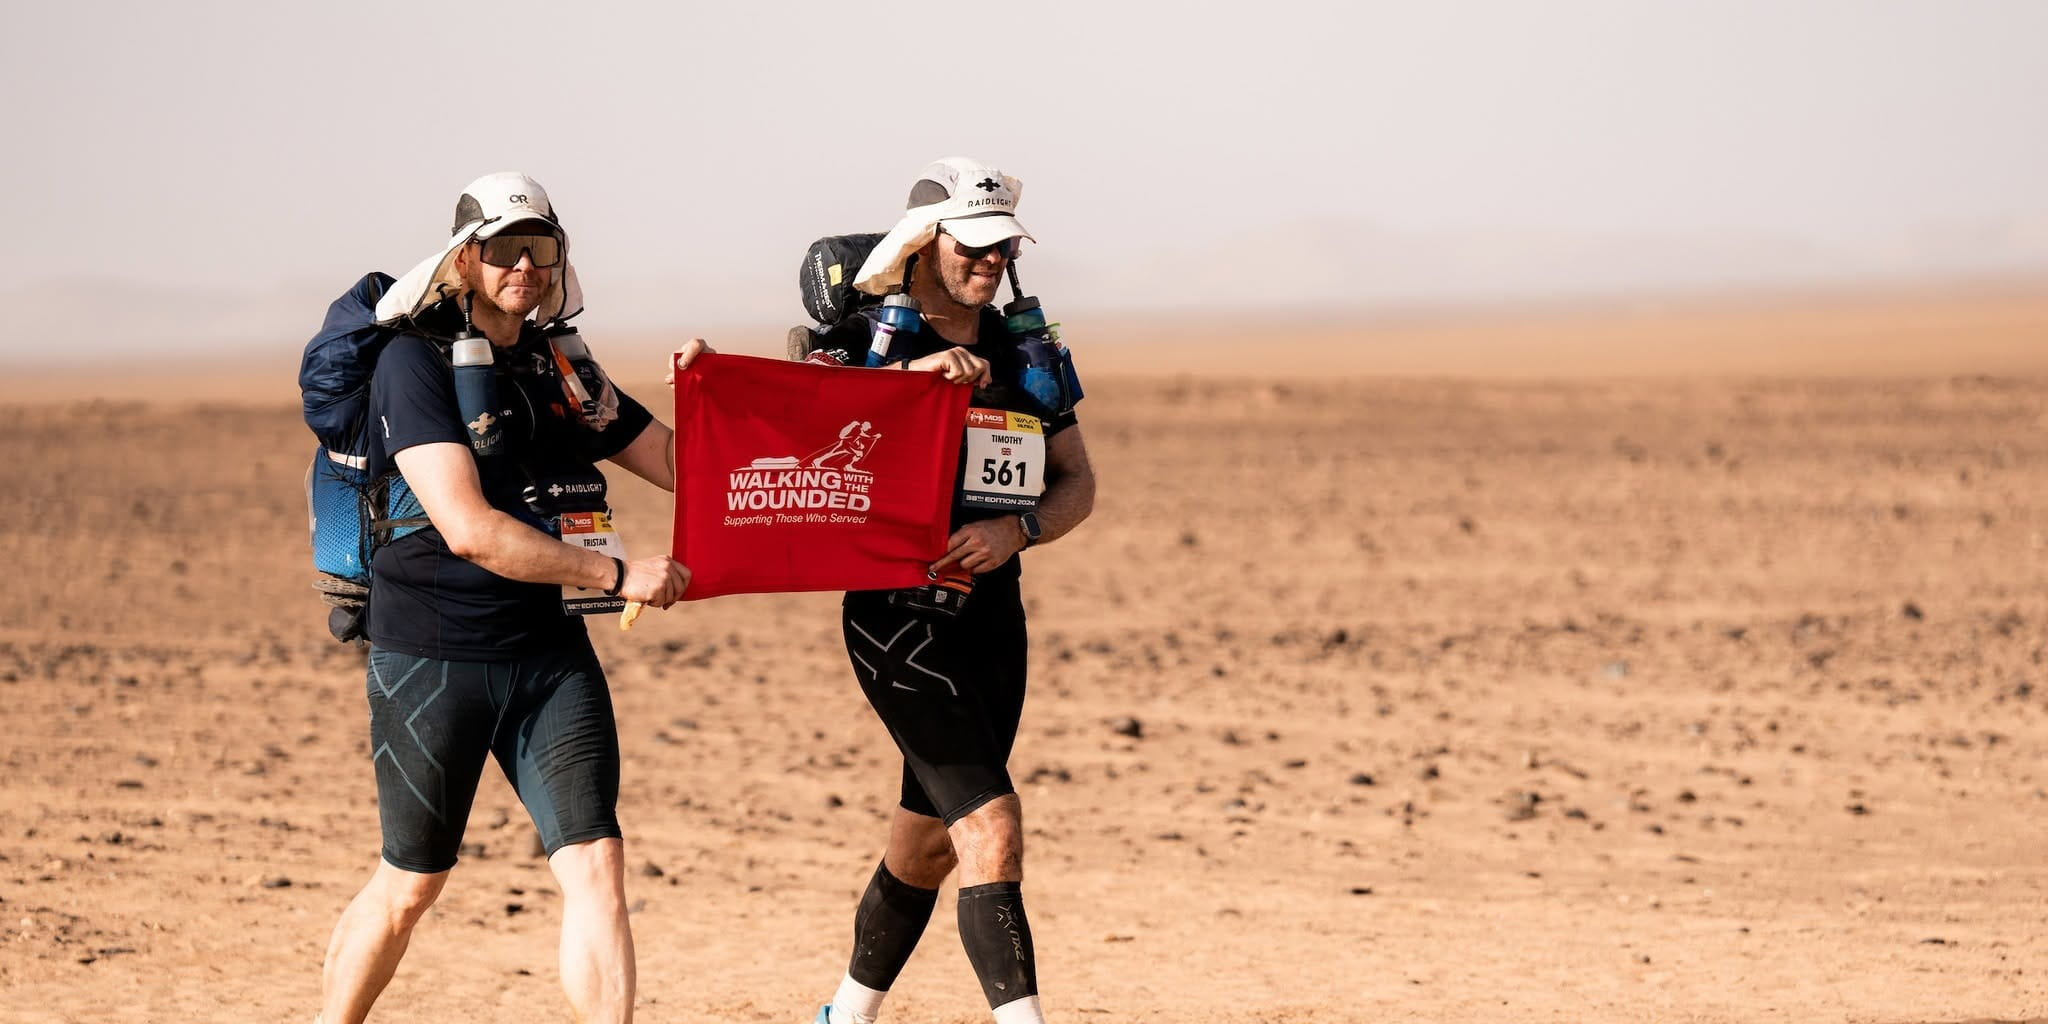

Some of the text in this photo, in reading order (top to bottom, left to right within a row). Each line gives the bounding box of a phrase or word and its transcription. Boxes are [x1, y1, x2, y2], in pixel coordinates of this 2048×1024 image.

[509, 194, 529, 204] OR
[967, 197, 1012, 208] RAIDLIGHT
[983, 414, 1004, 422] MDS
[991, 434, 1023, 445] TIMOTHY
[843, 473, 874, 484] WITH
[981, 458, 1027, 488] 561
[729, 470, 842, 490] WALKING
[565, 483, 603, 494] RAIDLIGHT
[844, 482, 869, 493] THE
[727, 489, 871, 512] WOUNDED
[984, 496, 1017, 505] EDITION
[724, 513, 868, 527] Supporting Those Who Served
[583, 537, 608, 548] TRISTAN
[581, 601, 611, 609] EDITION
